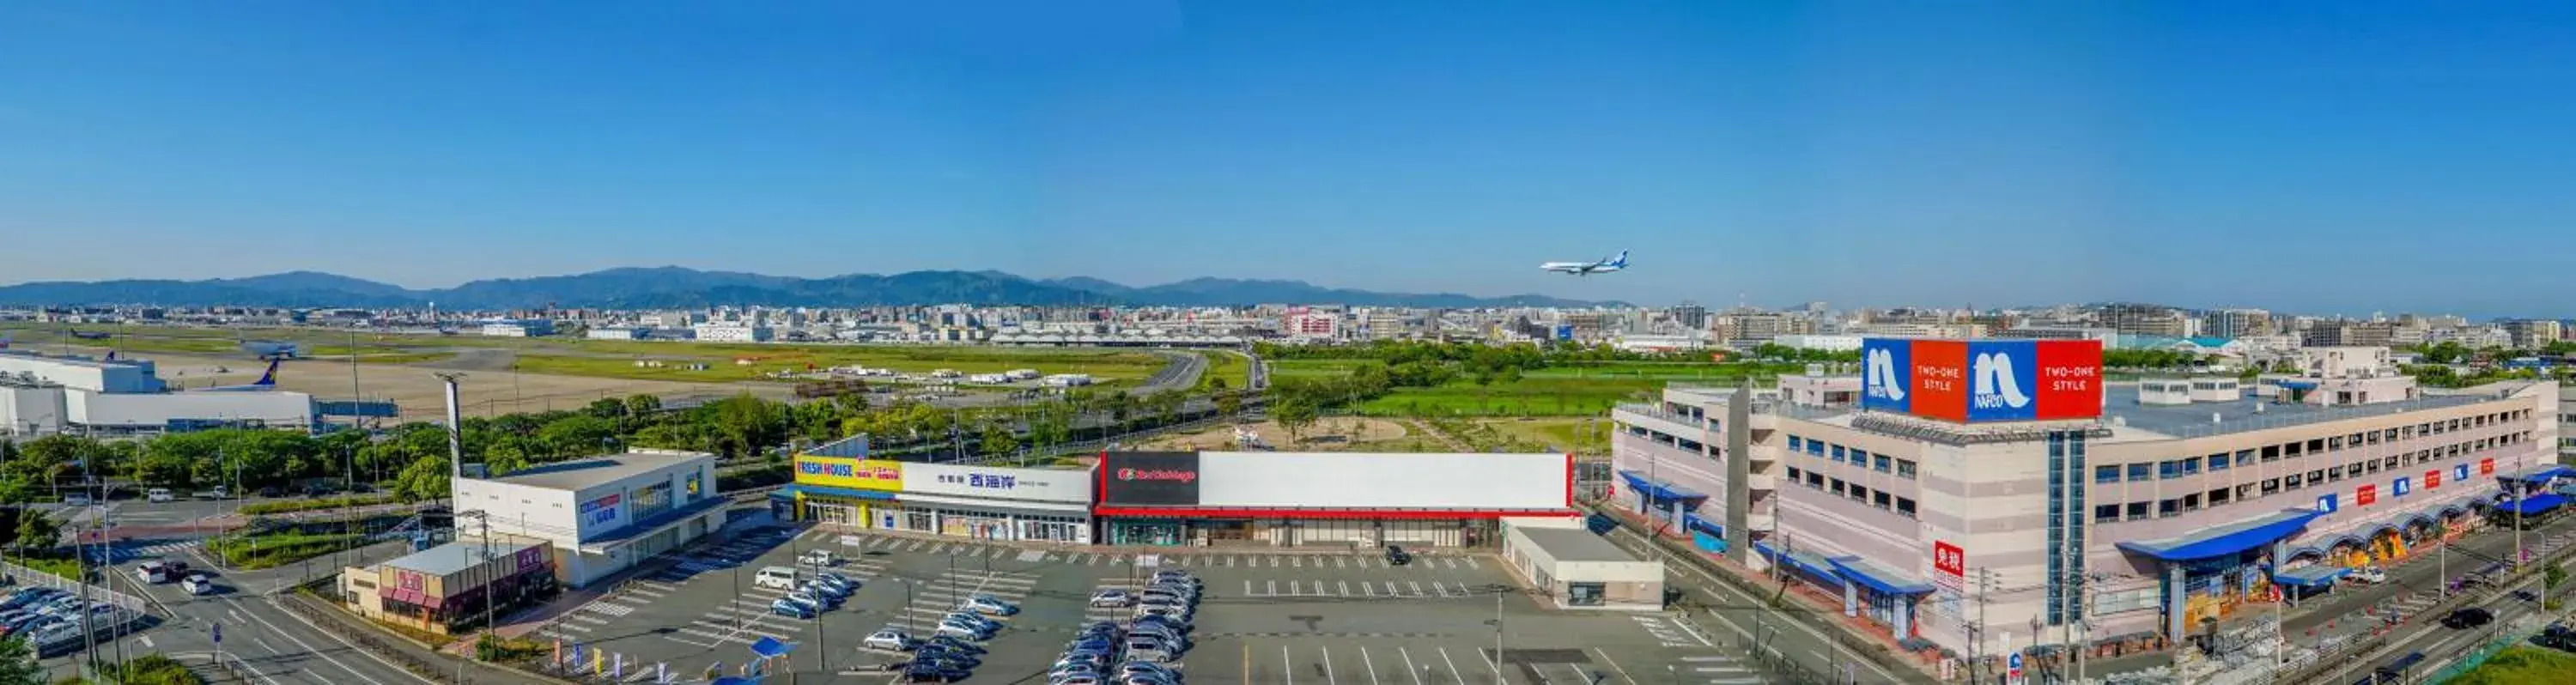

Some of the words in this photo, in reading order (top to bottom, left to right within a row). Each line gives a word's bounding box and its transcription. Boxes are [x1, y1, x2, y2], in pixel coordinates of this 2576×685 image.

[1917, 365, 1959, 378] TWO-ONE
[2045, 366, 2095, 377] TWO-ONE
[1923, 378, 1951, 391] STYLE
[2053, 380, 2087, 391] STYLE
